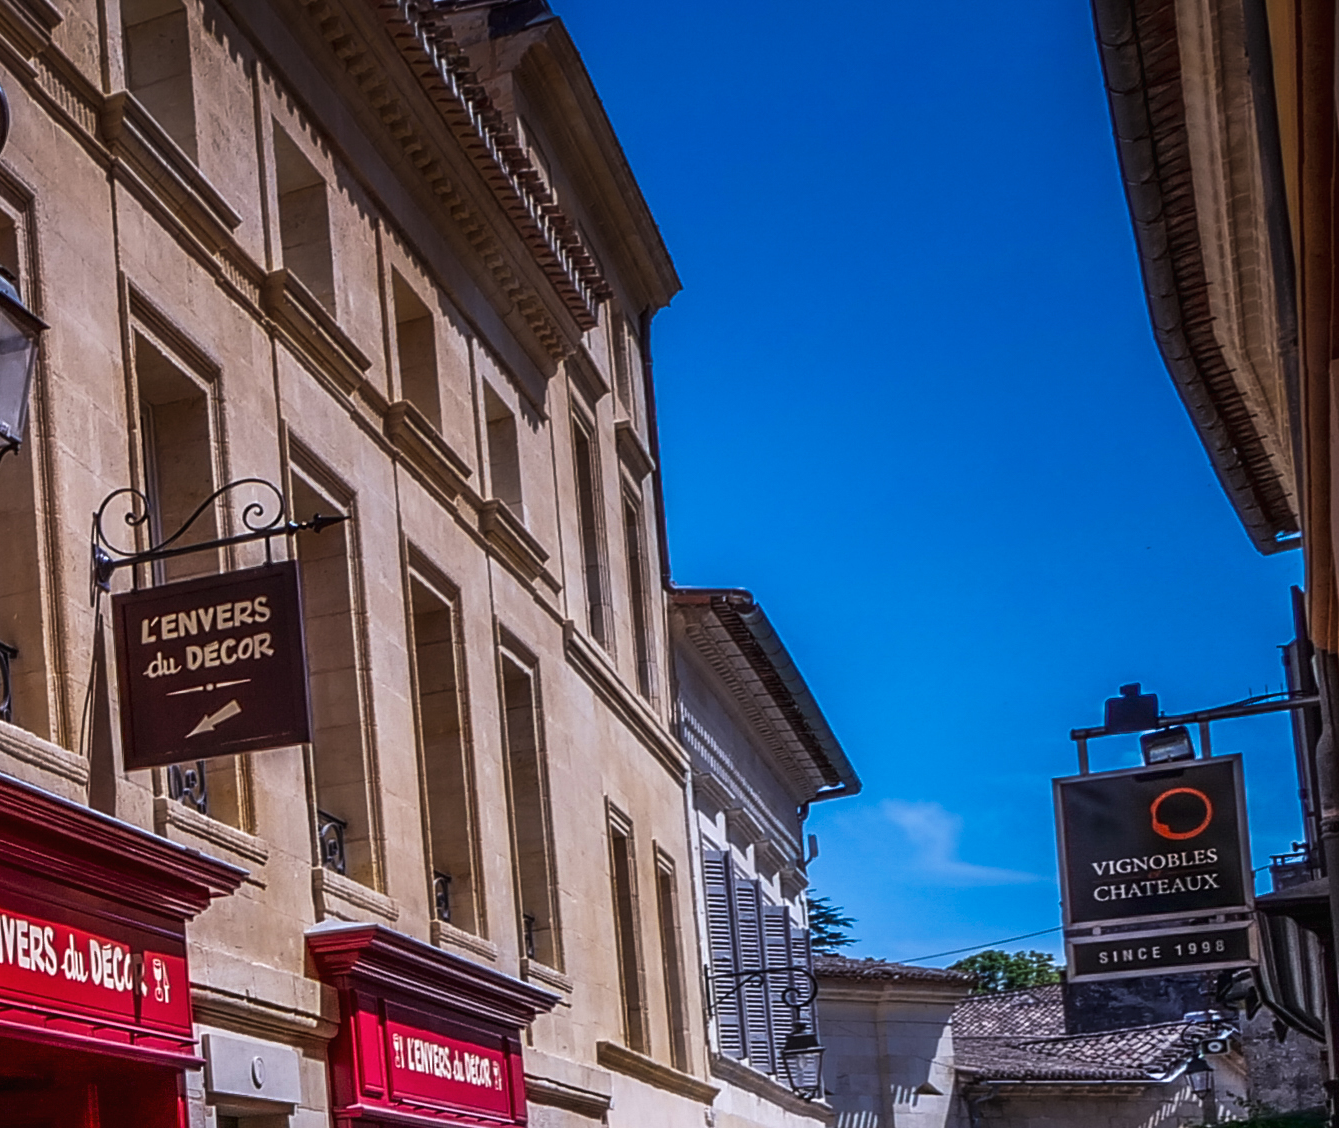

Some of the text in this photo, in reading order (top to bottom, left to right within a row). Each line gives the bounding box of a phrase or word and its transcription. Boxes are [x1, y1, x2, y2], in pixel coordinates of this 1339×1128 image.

[141, 596, 271, 645] L'ENVERS
[142, 651, 182, 679] du
[1091, 848, 1218, 877] VIGNOBLES
[1093, 873, 1220, 902] CHATEAUX
[61, 934, 89, 983] du
[90, 938, 147, 998] DÉCOR
[1099, 939, 1226, 965] SINCE 1998
[407, 1037, 452, 1080] L'ENVERS
[453, 1050, 465, 1082] du
